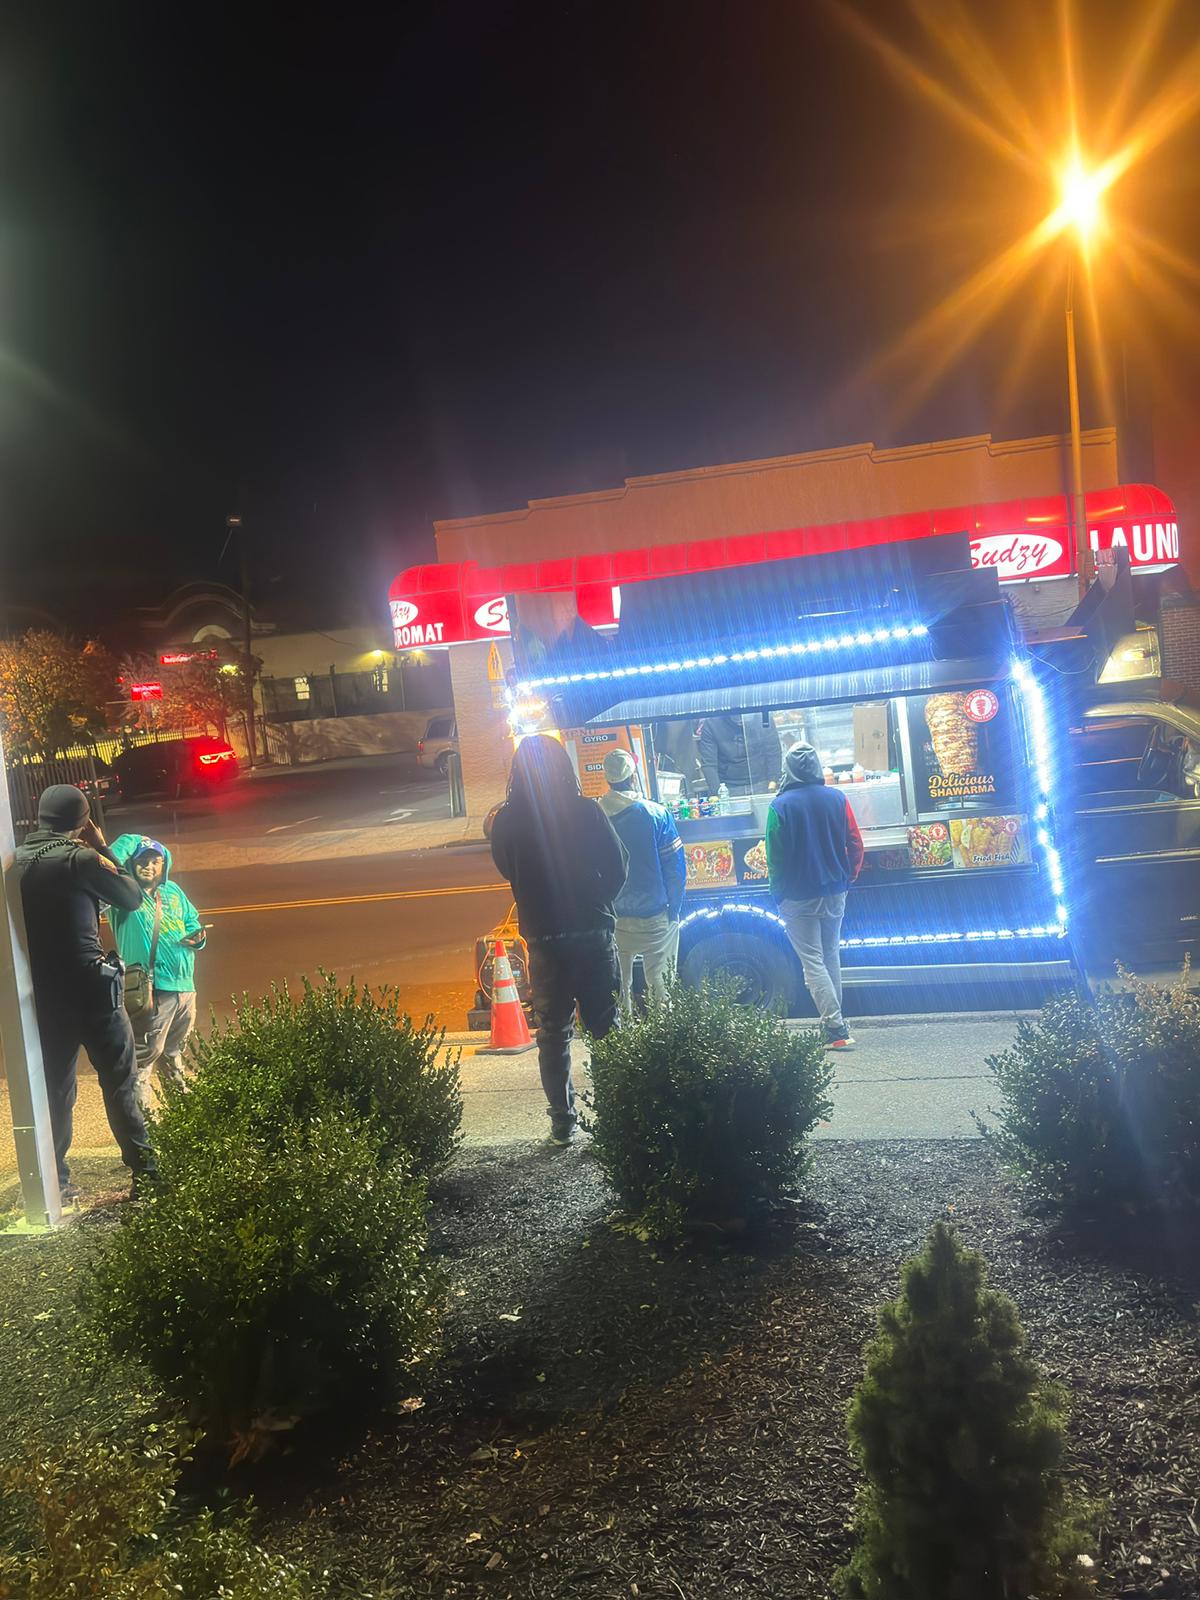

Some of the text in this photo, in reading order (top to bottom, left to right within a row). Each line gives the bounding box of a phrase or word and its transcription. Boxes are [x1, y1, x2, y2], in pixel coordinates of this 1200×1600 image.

[969, 537, 1049, 570] Sudzy
[584, 734, 609, 743] GYRO
[928, 773, 995, 789] Delicious
[930, 784, 996, 799] SHAWARMA
